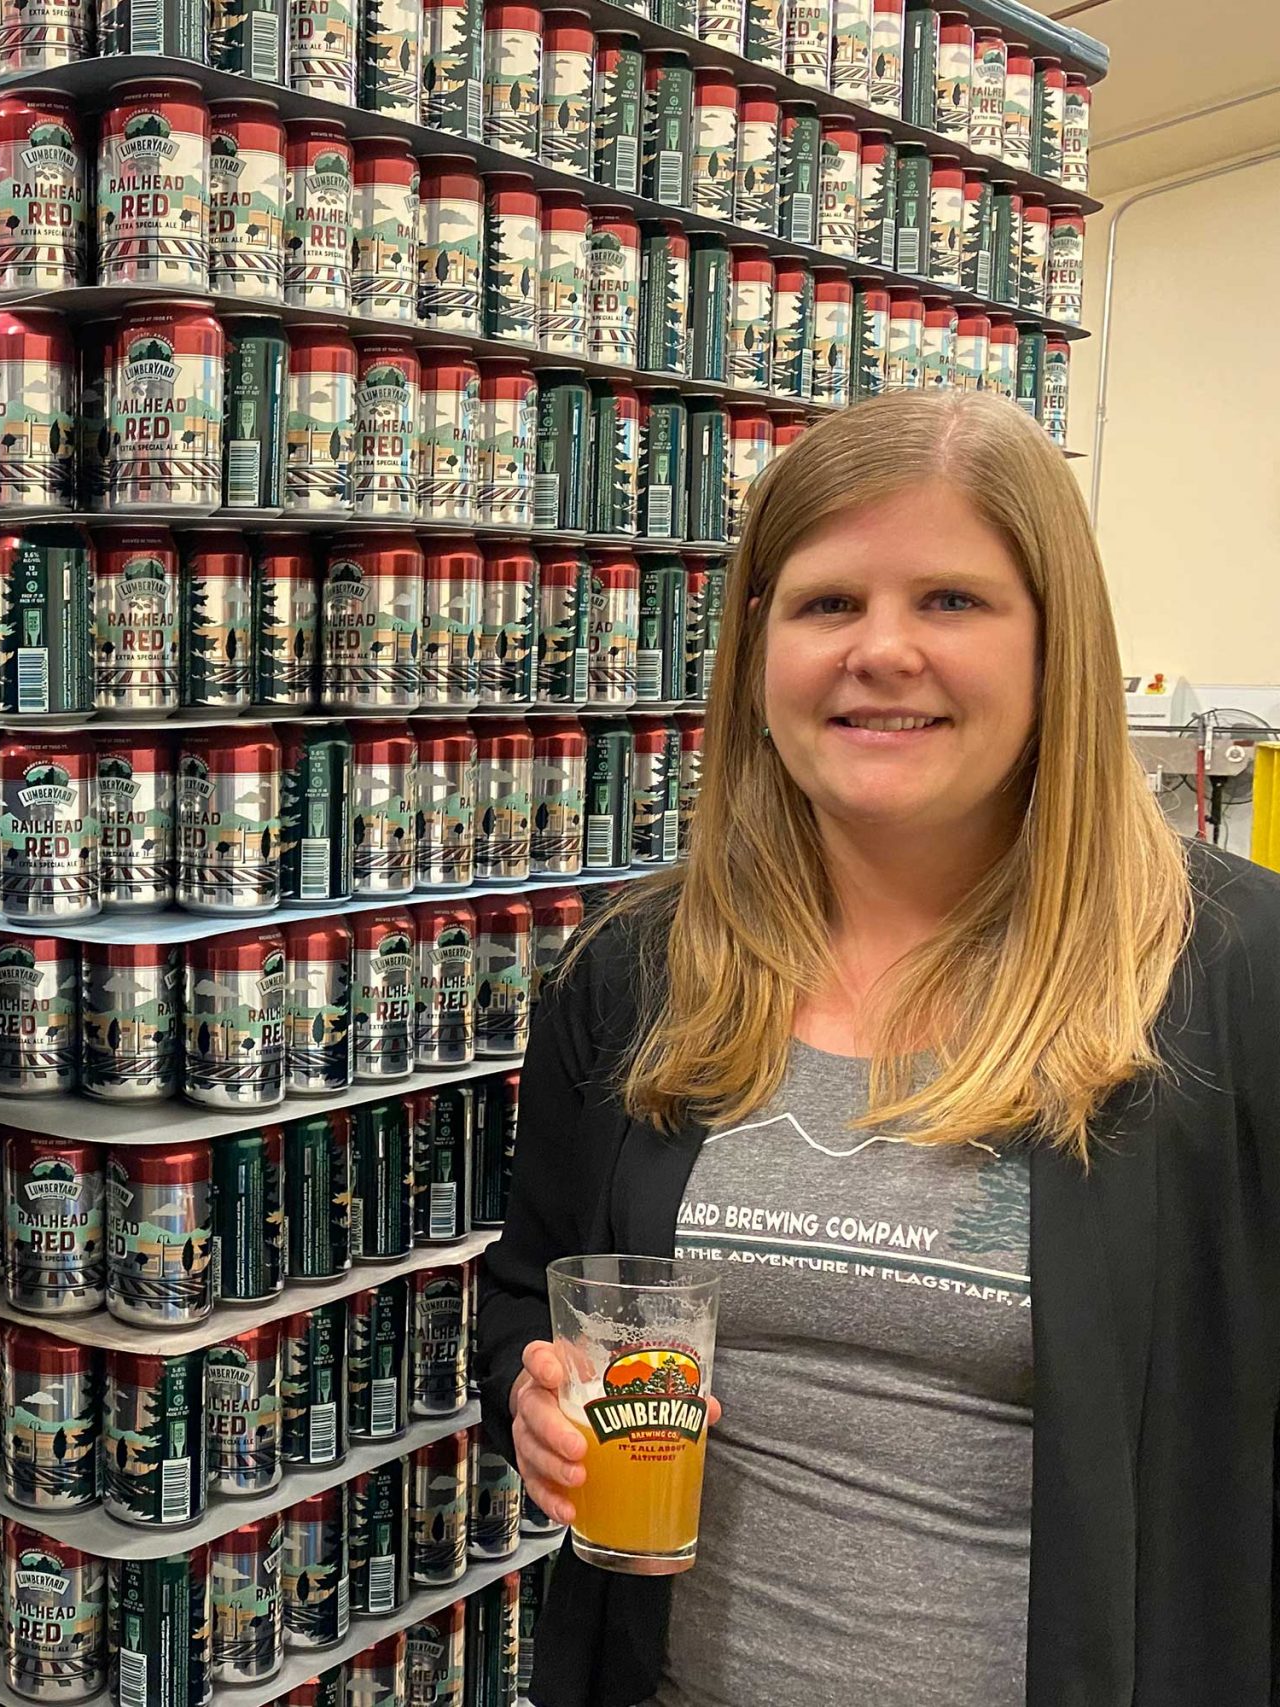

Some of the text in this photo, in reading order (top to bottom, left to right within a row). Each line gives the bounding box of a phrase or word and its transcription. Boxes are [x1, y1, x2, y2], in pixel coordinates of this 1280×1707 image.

[29, 8, 49, 17] EXTRA
[291, 0, 329, 15] HEAD
[790, 7, 820, 19] HEAD
[786, 21, 809, 38] ED
[1066, 128, 1087, 138] HEAD
[119, 138, 176, 159] LUMBERYARD
[1064, 139, 1081, 152] ED
[25, 147, 75, 167] LUMBERYARD
[211, 157, 240, 173] ERYARD
[12, 184, 82, 202] RAILHEAD
[110, 175, 185, 194] RAILHEAD
[121, 193, 170, 219] RED
[211, 191, 251, 207] HEAD
[28, 202, 72, 227] RED
[210, 210, 236, 233] ED
[21, 228, 42, 236] EXTRA
[114, 221, 177, 231] EXTRA SPECIAL ALE
[231, 236, 244, 244] ALE
[310, 225, 348, 250] RED
[303, 249, 323, 257] EXTRA
[1049, 270, 1077, 284] RED
[590, 279, 629, 293] LHEAD
[593, 294, 619, 312] ED
[125, 362, 176, 379] LUMBERYARD
[361, 384, 409, 404] LUMBERYARD
[117, 397, 187, 415] RAILHEAD
[125, 417, 171, 442] RED
[357, 419, 414, 435] AILHEAD
[166, 443, 179, 451] ALE
[362, 435, 404, 458] RED
[120, 580, 167, 598] LUMBERYARD
[108, 613, 174, 627] RAILHEAD
[122, 629, 164, 651] RED
[22, 788, 73, 802] LUMBERYARD
[12, 819, 83, 834] RAILHEAD
[101, 811, 146, 825] LHEAD
[101, 827, 131, 847] ED
[25, 836, 70, 858] RED
[362, 985, 415, 999] RAILHEA
[434, 992, 469, 1012] RED
[376, 1001, 409, 1021] RED
[28, 1181, 78, 1197] LUMBERYARD
[18, 1211, 89, 1228] RAILHEAD
[725, 1206, 820, 1236] BREWING
[826, 1216, 940, 1251] COMPANY
[31, 1230, 76, 1253] RED
[688, 1248, 723, 1261] THE
[728, 1249, 849, 1274] ADVENTURE
[855, 1264, 876, 1278] IN
[881, 1268, 1013, 1306] FLAGSTAFF,
[1019, 1295, 1032, 1308] A
[593, 1399, 703, 1434] LUMBERYARD
[631, 1431, 678, 1439] BREWING CO.
[658, 1444, 686, 1452] ABOUT
[17, 1571, 64, 1590] LUMBERYARD
[19, 1618, 62, 1643] RED
